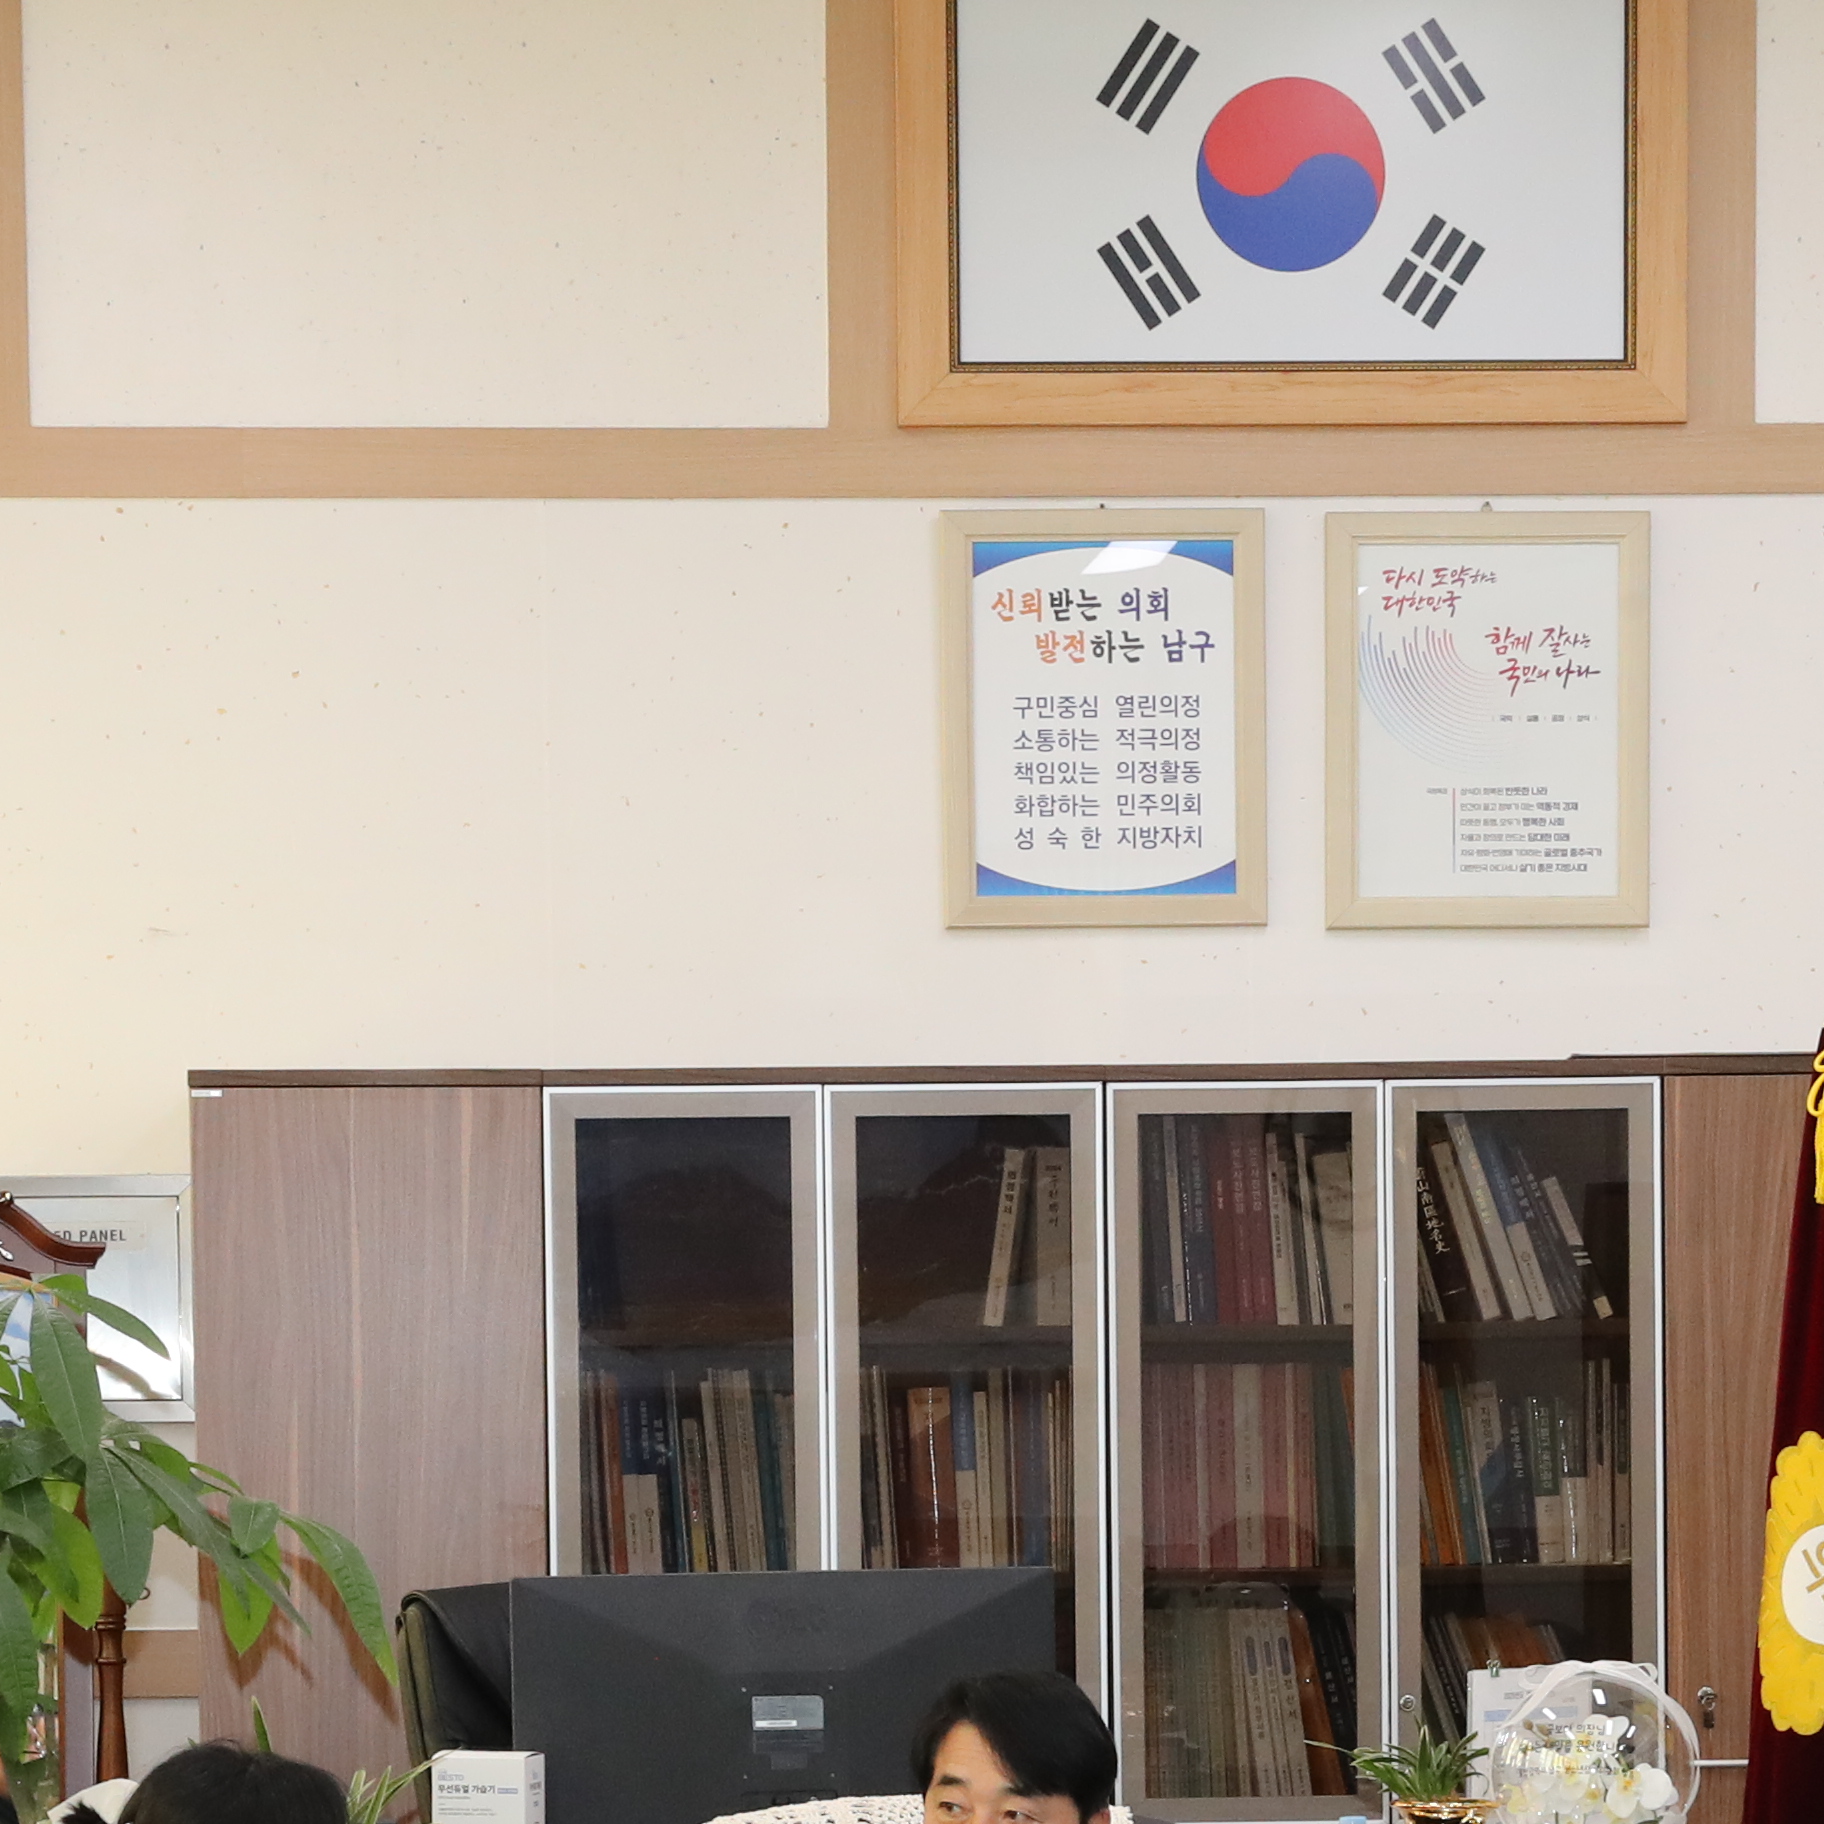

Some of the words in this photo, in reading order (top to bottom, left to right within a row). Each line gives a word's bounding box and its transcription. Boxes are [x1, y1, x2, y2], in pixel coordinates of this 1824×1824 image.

[1382, 566, 1424, 590] 다시
[1430, 565, 1498, 588] 도약하는
[991, 588, 1102, 625] 신뢰받는
[1118, 588, 1170, 621] 의회
[1381, 591, 1461, 618] 대한민국
[1035, 630, 1144, 664] 발전하는
[1161, 630, 1216, 663] 남구
[1484, 625, 1533, 656] 함께
[1538, 625, 1591, 658] 잘사는
[1498, 658, 1550, 697] 국민의
[1555, 658, 1601, 690] 나라
[1013, 695, 1099, 720] 구민중심
[1115, 694, 1201, 720] 열린의정
[1013, 728, 1099, 752] 소통하는
[1116, 727, 1201, 752] 적극의정
[1014, 760, 1100, 785] 책임있는
[1116, 759, 1202, 785] 의정활동
[1014, 793, 1100, 818] 화합하는
[1117, 792, 1202, 817] 민주의회
[1014, 827, 1034, 850] 성
[1048, 827, 1067, 850] 숙
[1081, 827, 1101, 850] 한
[1117, 825, 1203, 850] 지방자치
[79, 1229, 127, 1242] PANEL
[471, 1785, 495, 1794] 가습기
